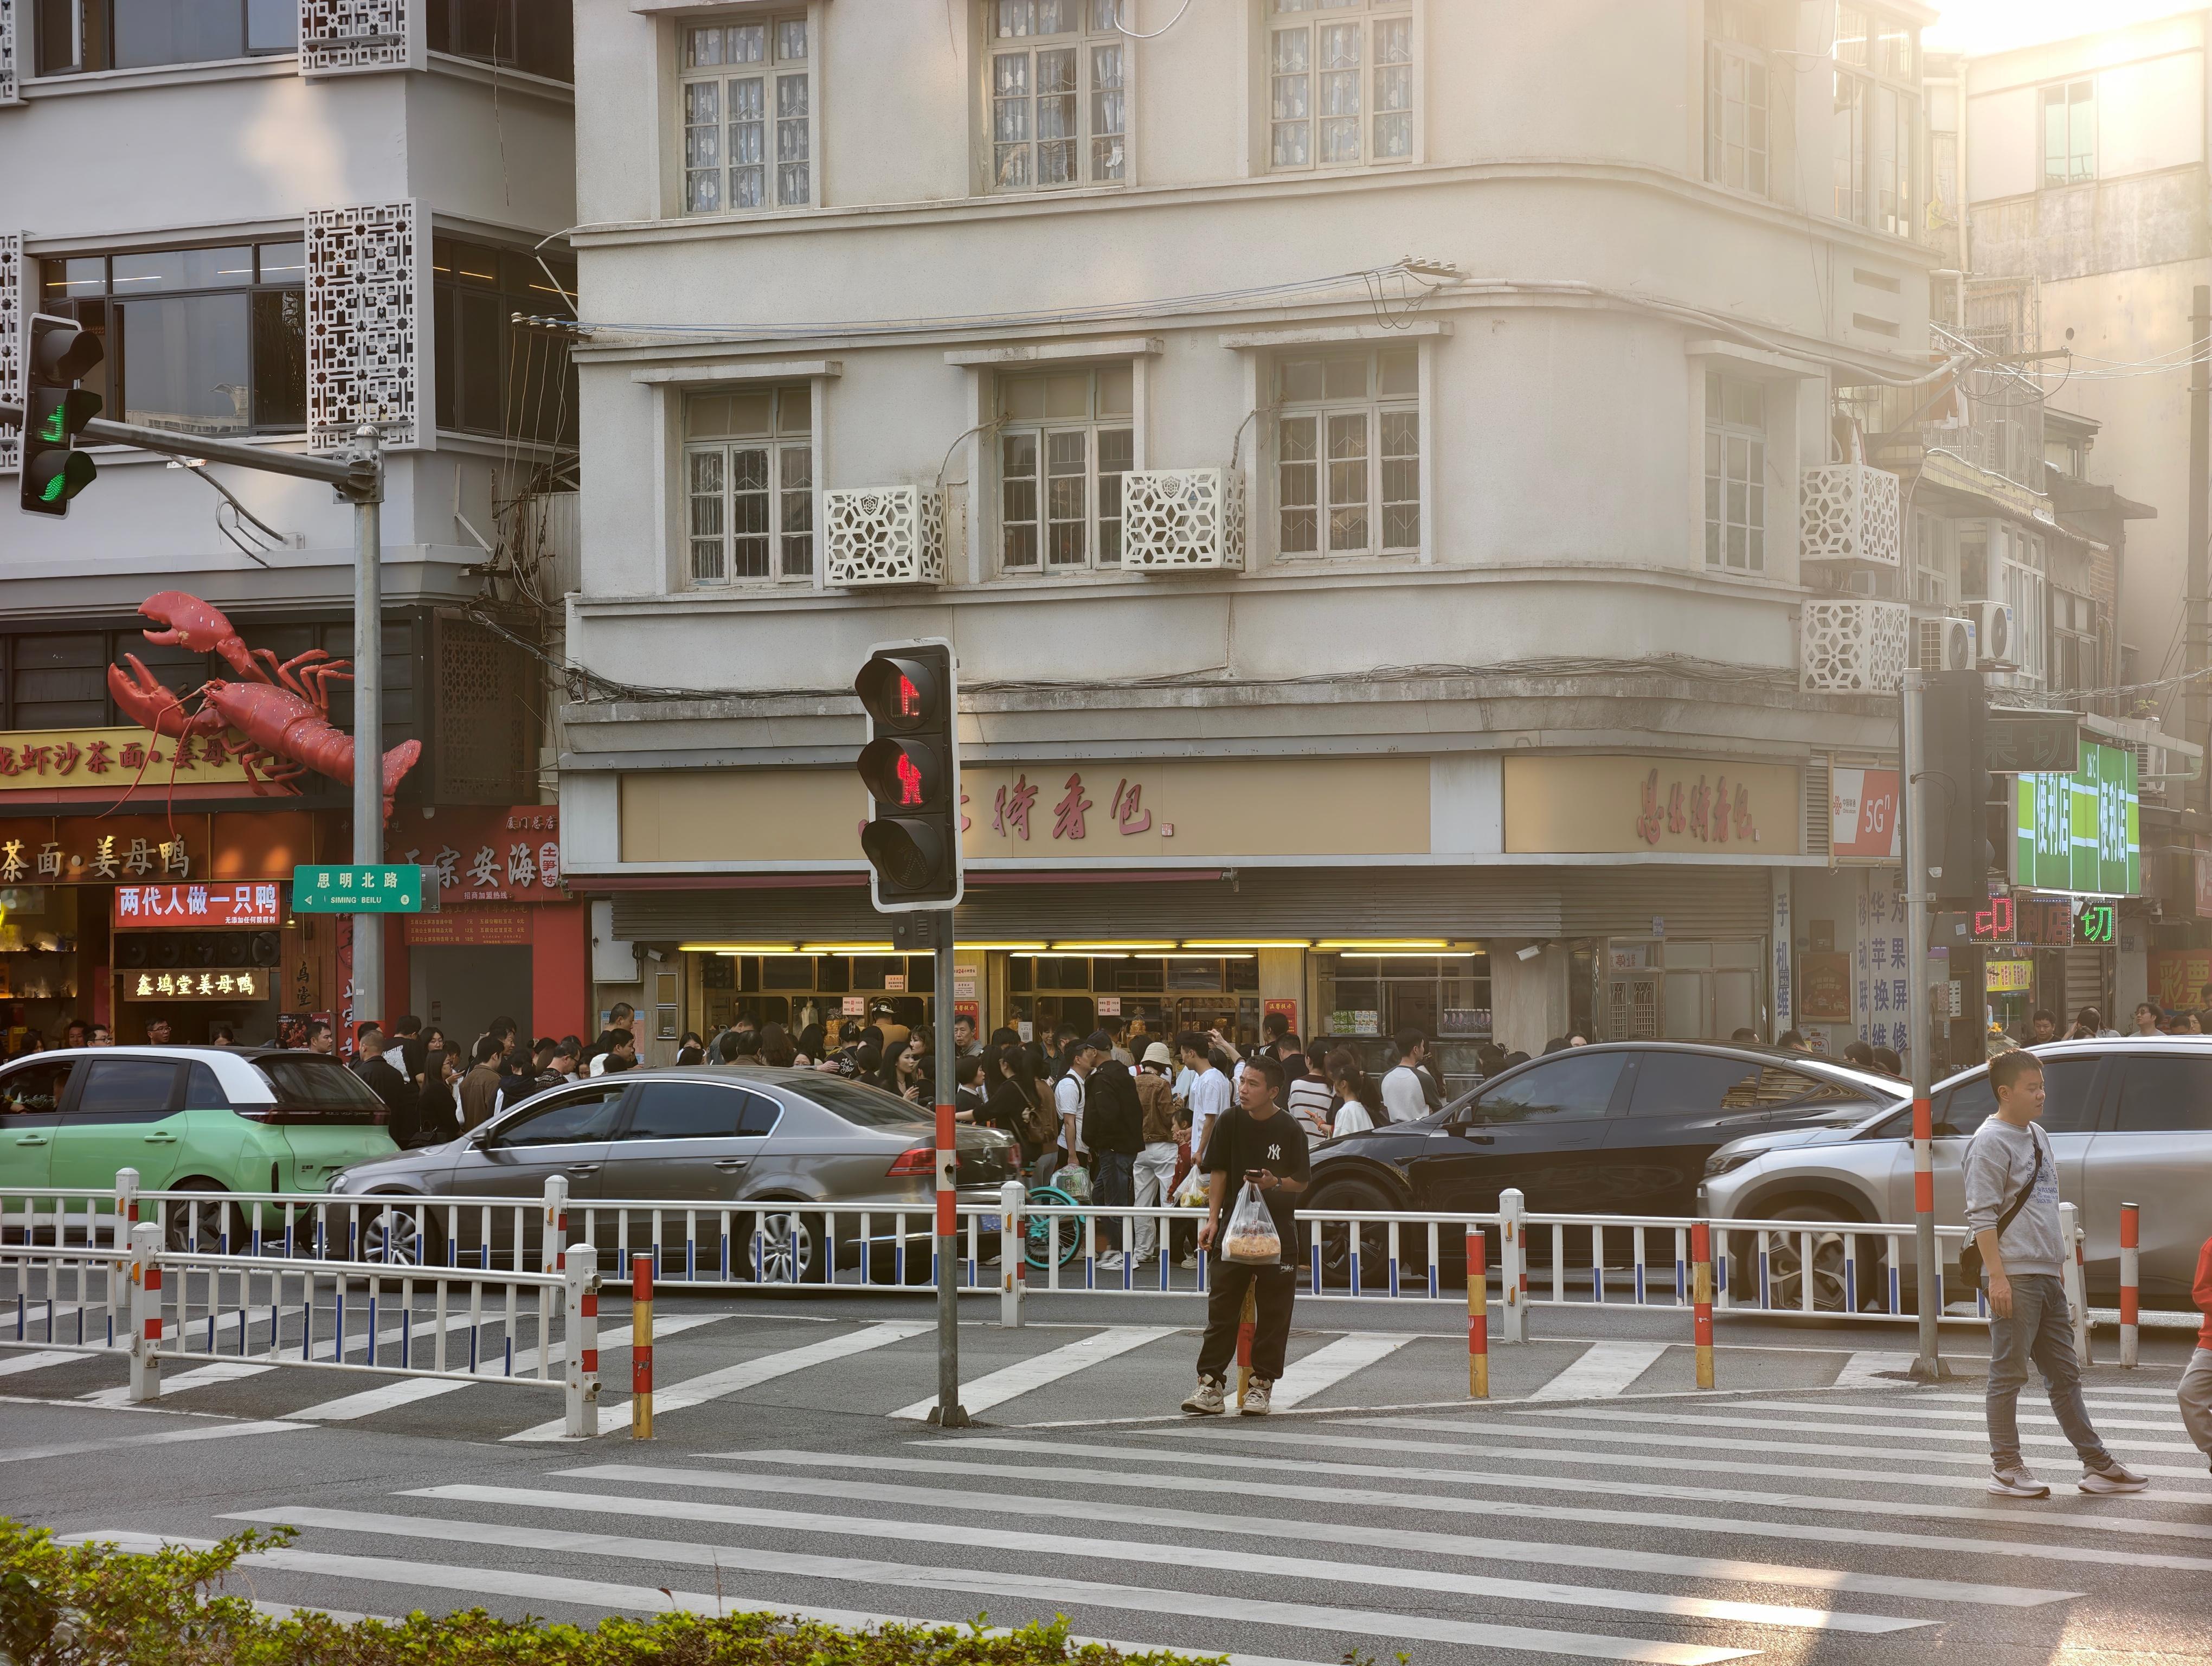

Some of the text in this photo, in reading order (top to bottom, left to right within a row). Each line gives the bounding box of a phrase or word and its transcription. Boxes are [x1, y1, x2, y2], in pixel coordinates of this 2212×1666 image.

[505, 815, 555, 830] 厦门总店
[961, 772, 1150, 841] 特香包
[2100, 776, 2126, 862] 便利店
[317, 873, 398, 889] 思明北路
[542, 847, 557, 885] 土笋冻
[119, 885, 276, 916] 两代人做一只鸭
[1976, 898, 2012, 938] 印
[2081, 907, 2112, 941] 切
[1872, 938, 1906, 970] 苹果
[1874, 979, 1908, 1011] 换屏
[2160, 959, 2209, 1003] 彩票
[1872, 1022, 1908, 1054] 维修
[1267, 1144, 1282, 1161] NY
